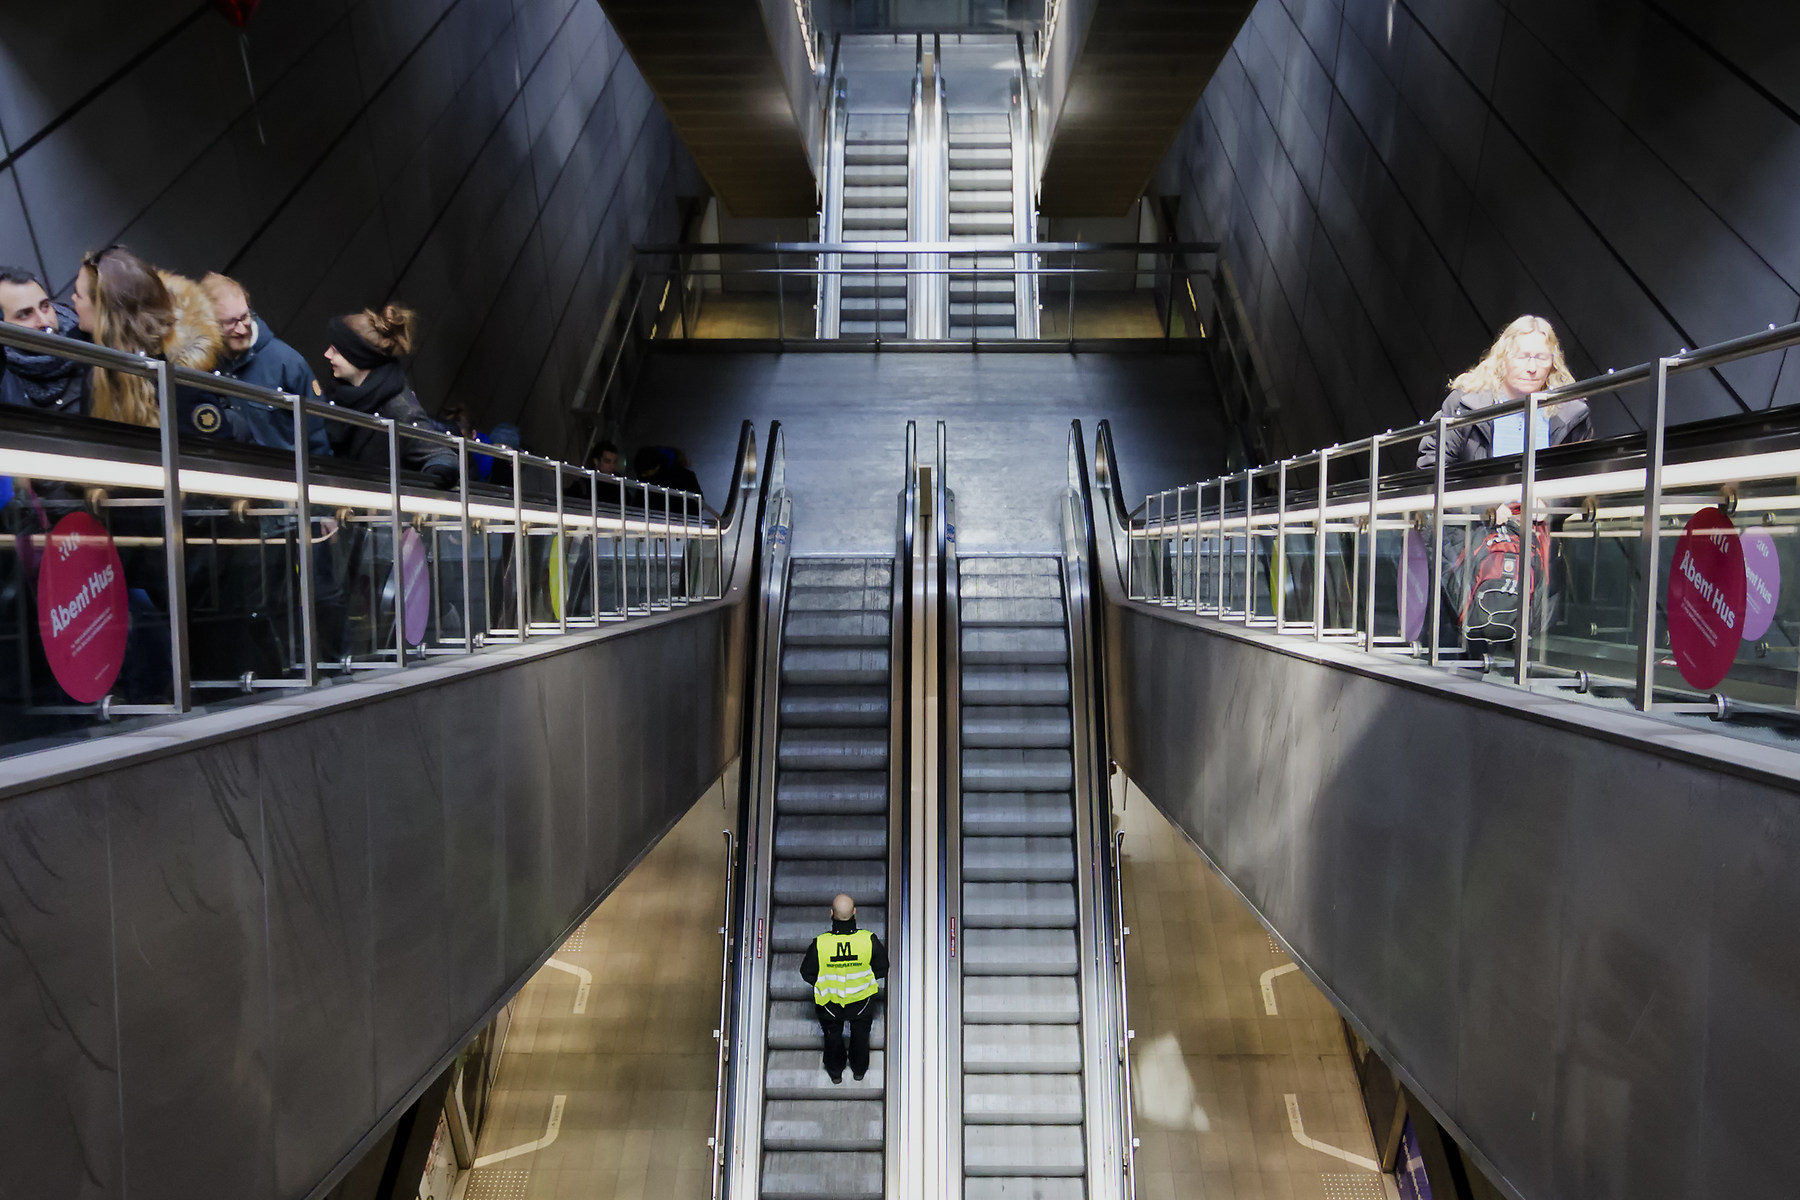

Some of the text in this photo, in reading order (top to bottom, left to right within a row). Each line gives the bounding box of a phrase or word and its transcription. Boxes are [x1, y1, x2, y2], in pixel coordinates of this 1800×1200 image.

[50, 583, 91, 638] Åbent
[88, 564, 115, 599] Hus
[1680, 550, 1713, 602] Åbent
[1712, 588, 1736, 630] Hus
[1756, 577, 1773, 606] Hus
